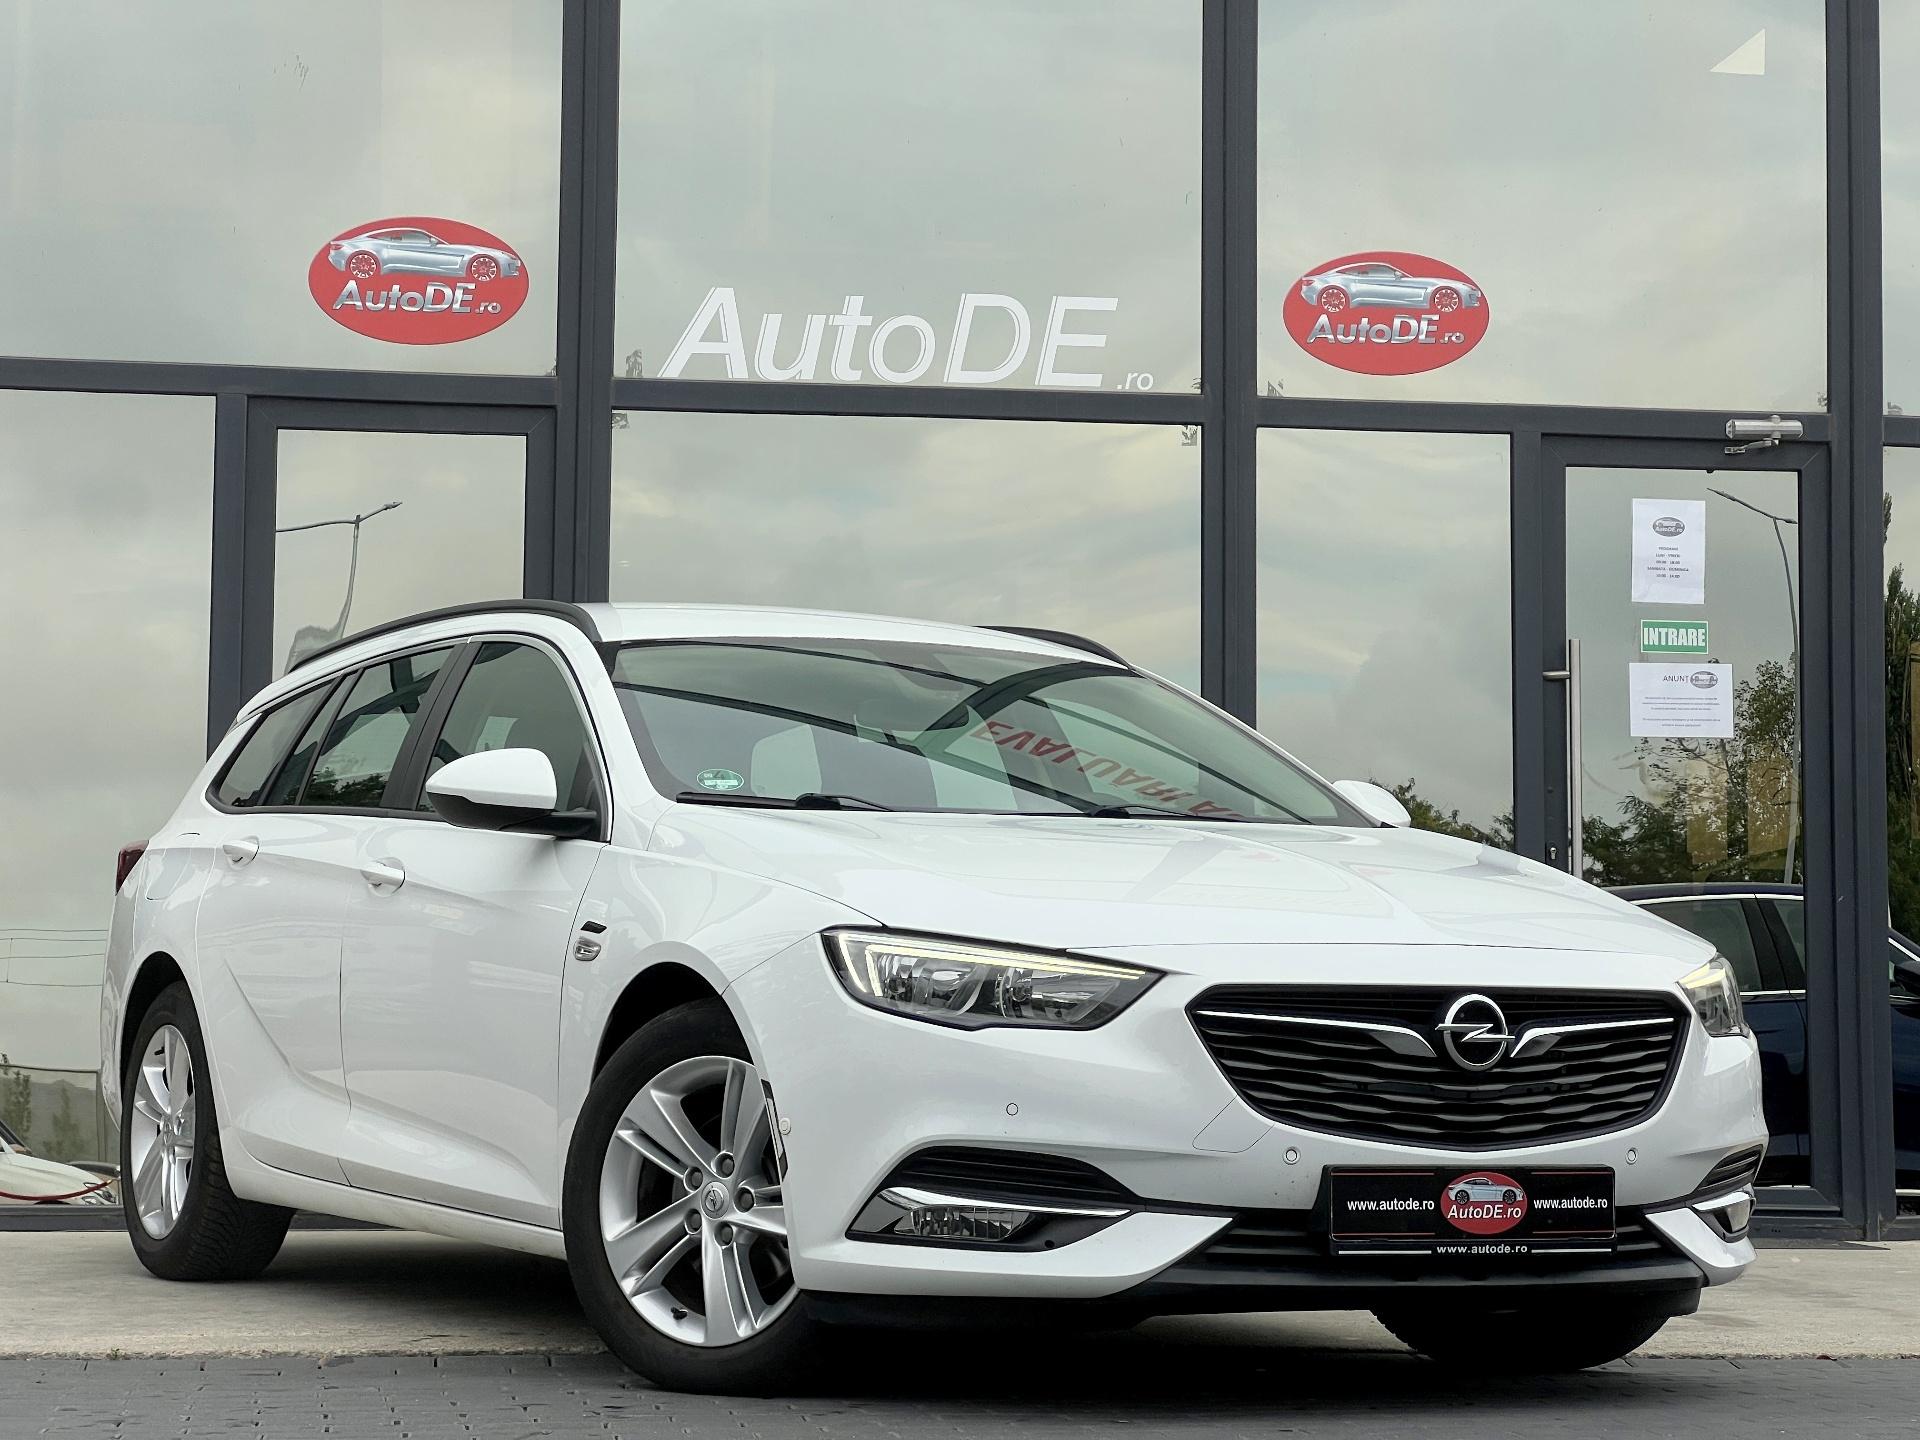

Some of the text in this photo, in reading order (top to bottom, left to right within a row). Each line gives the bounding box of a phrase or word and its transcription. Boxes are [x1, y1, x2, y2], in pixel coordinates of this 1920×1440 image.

[1643, 627, 1706, 646] INTRARE
[1347, 1198, 1435, 1211] www.autode.ro
[1533, 1197, 1608, 1210] www.autode.ro
[1448, 1204, 1522, 1219] AutoDE.ro
[1436, 1243, 1528, 1254] www.autode.ro
